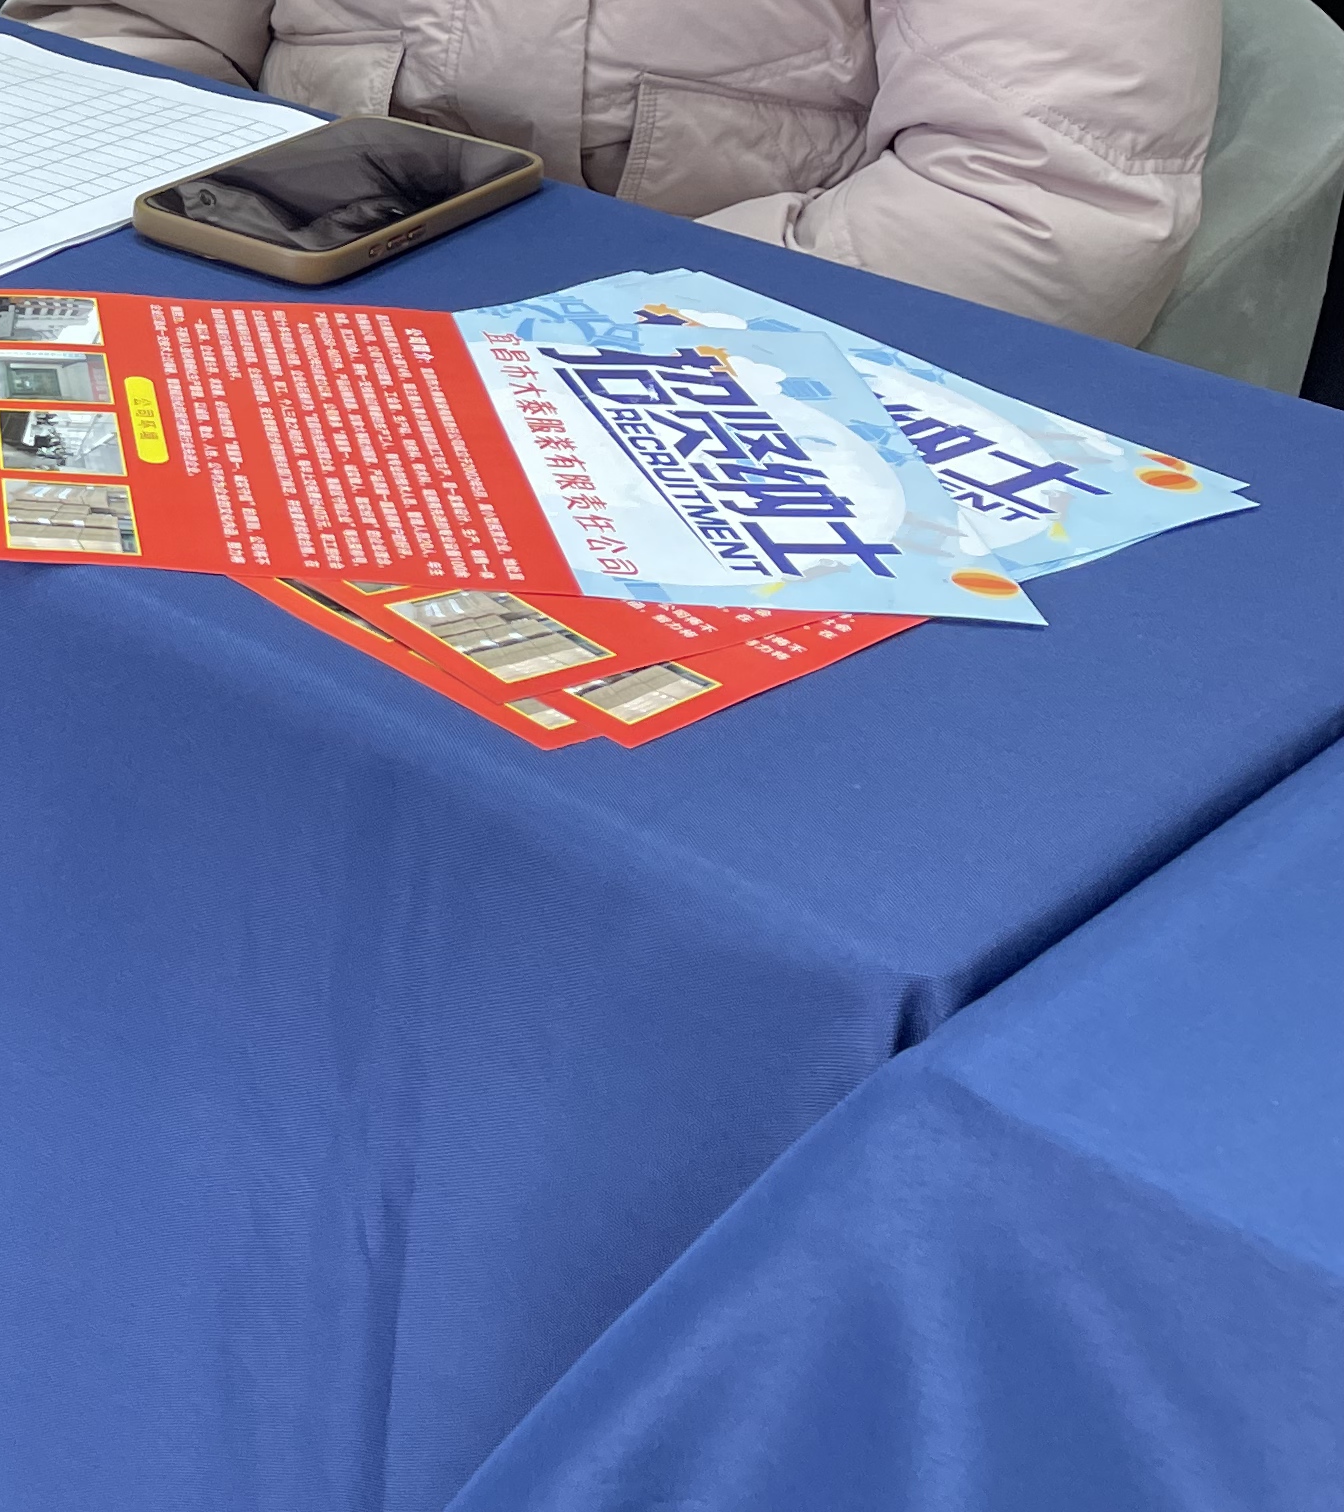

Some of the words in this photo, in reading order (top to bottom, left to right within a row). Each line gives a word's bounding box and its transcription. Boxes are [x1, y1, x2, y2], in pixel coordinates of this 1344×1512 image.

[481, 329, 641, 578] 宜昌市大泰服装有限责任公司
[536, 346, 904, 579] 招贤纳士
[603, 406, 772, 578] RECRUITMENT
